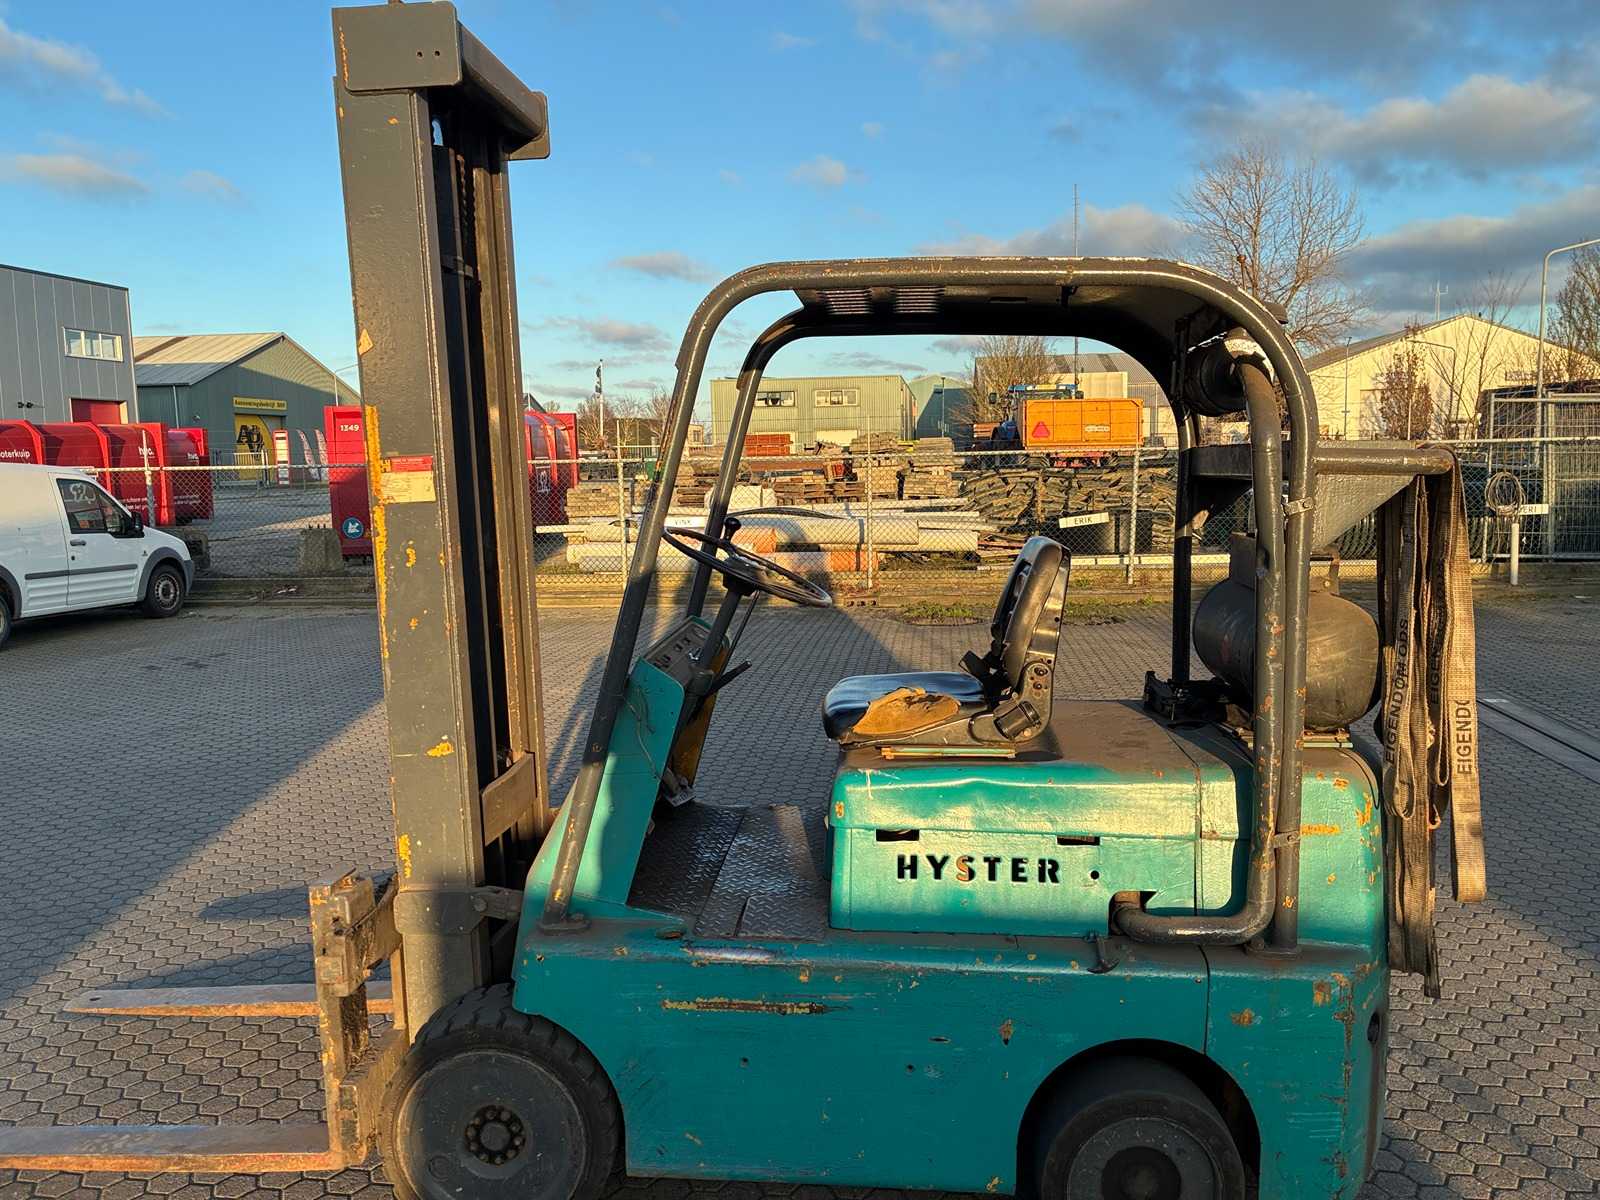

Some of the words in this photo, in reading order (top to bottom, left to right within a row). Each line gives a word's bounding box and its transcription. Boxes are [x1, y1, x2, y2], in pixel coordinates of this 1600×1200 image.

[340, 424, 359, 432] 1349
[1074, 516, 1093, 525] ERIK
[898, 855, 1059, 884] HYSTER
